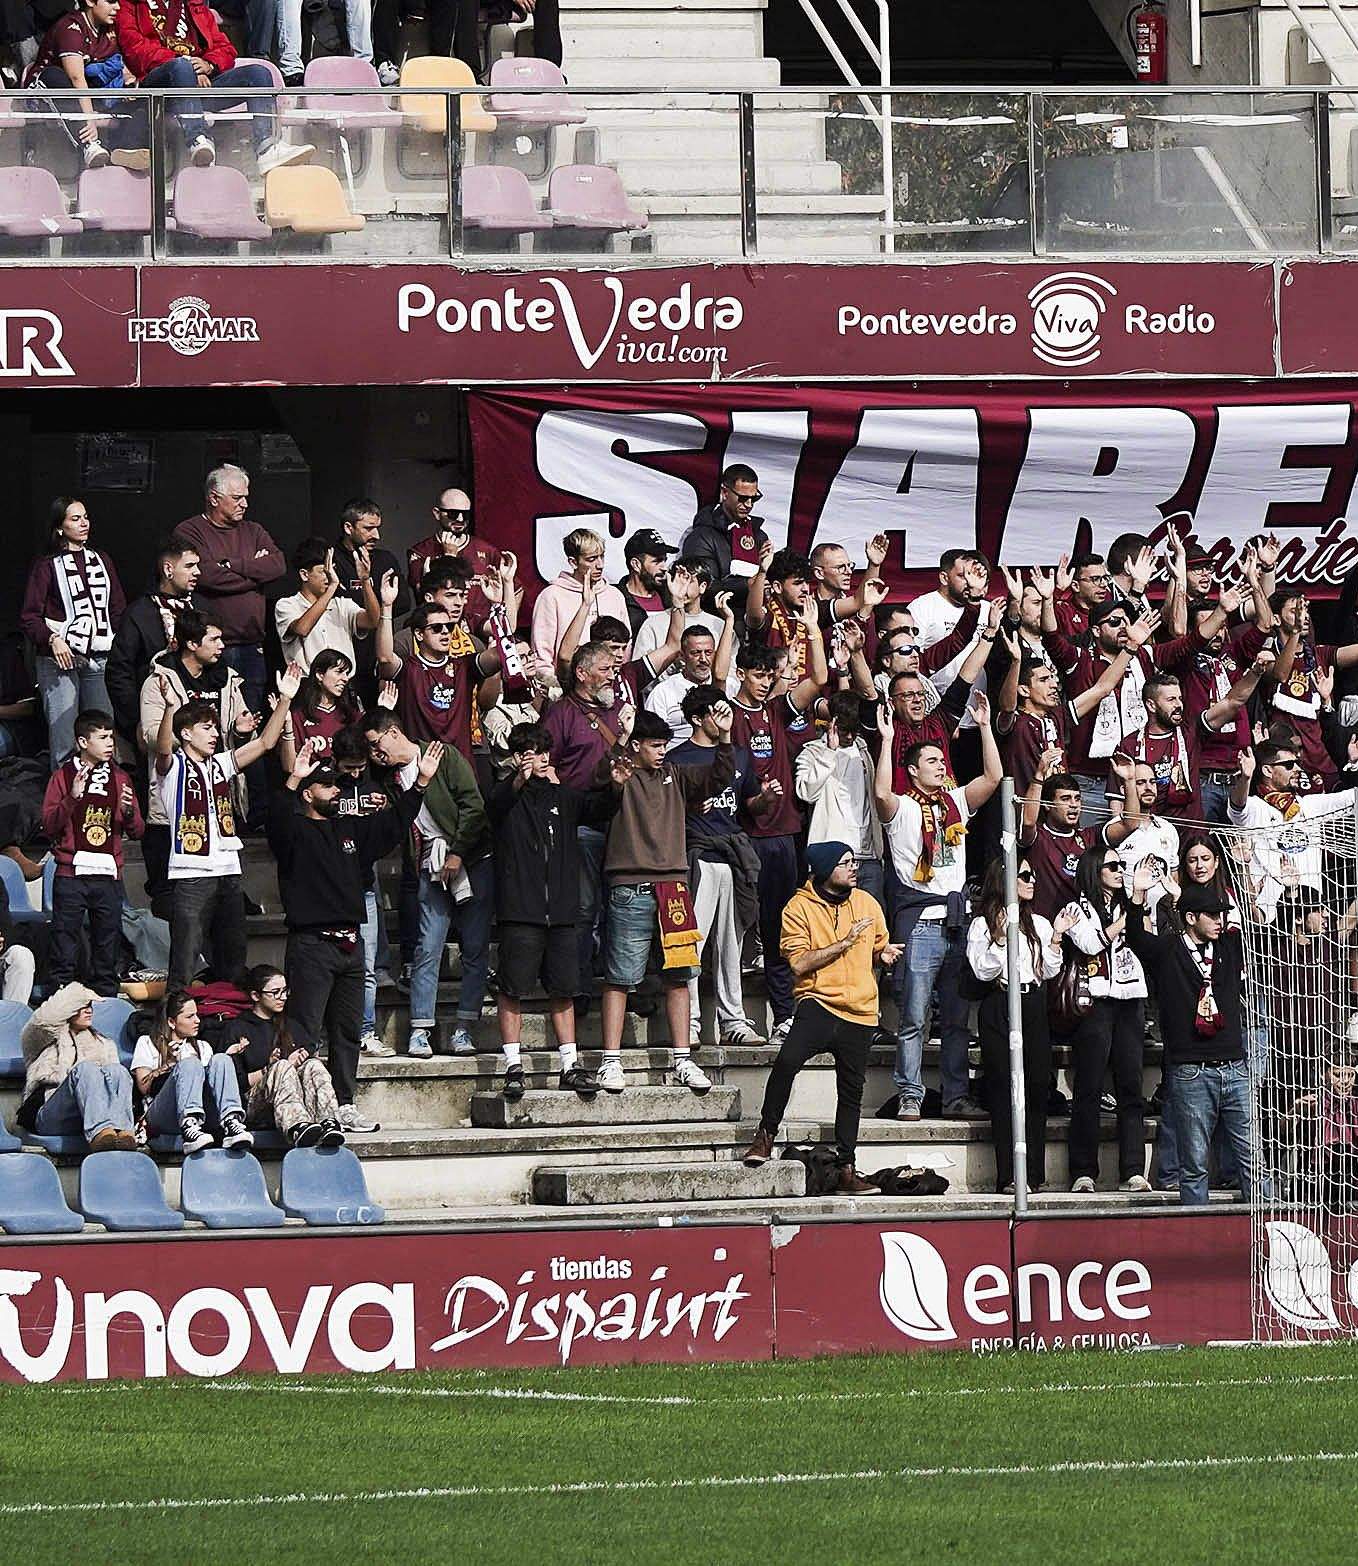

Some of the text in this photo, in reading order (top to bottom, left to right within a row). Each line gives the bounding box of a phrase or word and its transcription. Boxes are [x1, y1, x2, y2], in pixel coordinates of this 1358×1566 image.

[129, 318, 259, 341] PESCAMAR
[838, 304, 1215, 335] Pontevedra Viva Radio
[550, 1256, 632, 1281] tiendas
[963, 1260, 1152, 1325] ence
[430, 1266, 751, 1366] Dispaint
